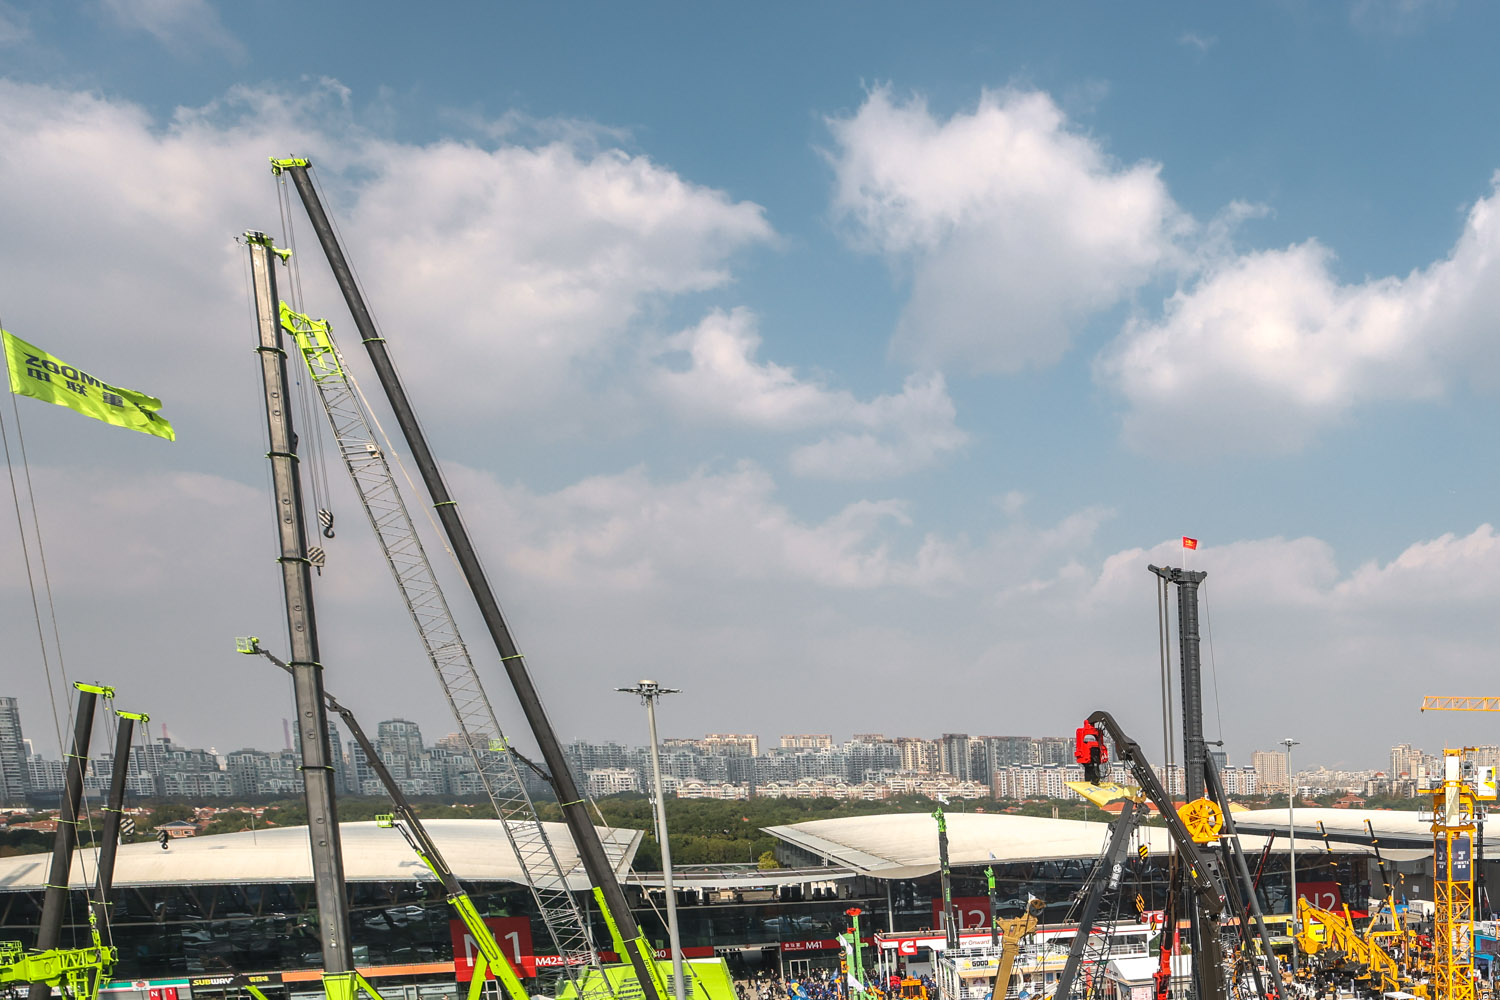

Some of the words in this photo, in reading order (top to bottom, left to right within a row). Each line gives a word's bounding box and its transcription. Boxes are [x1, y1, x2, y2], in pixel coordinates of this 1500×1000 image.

[805, 941, 823, 949] M41
[535, 957, 558, 966] M42
[193, 978, 233, 986] SUBWAY
